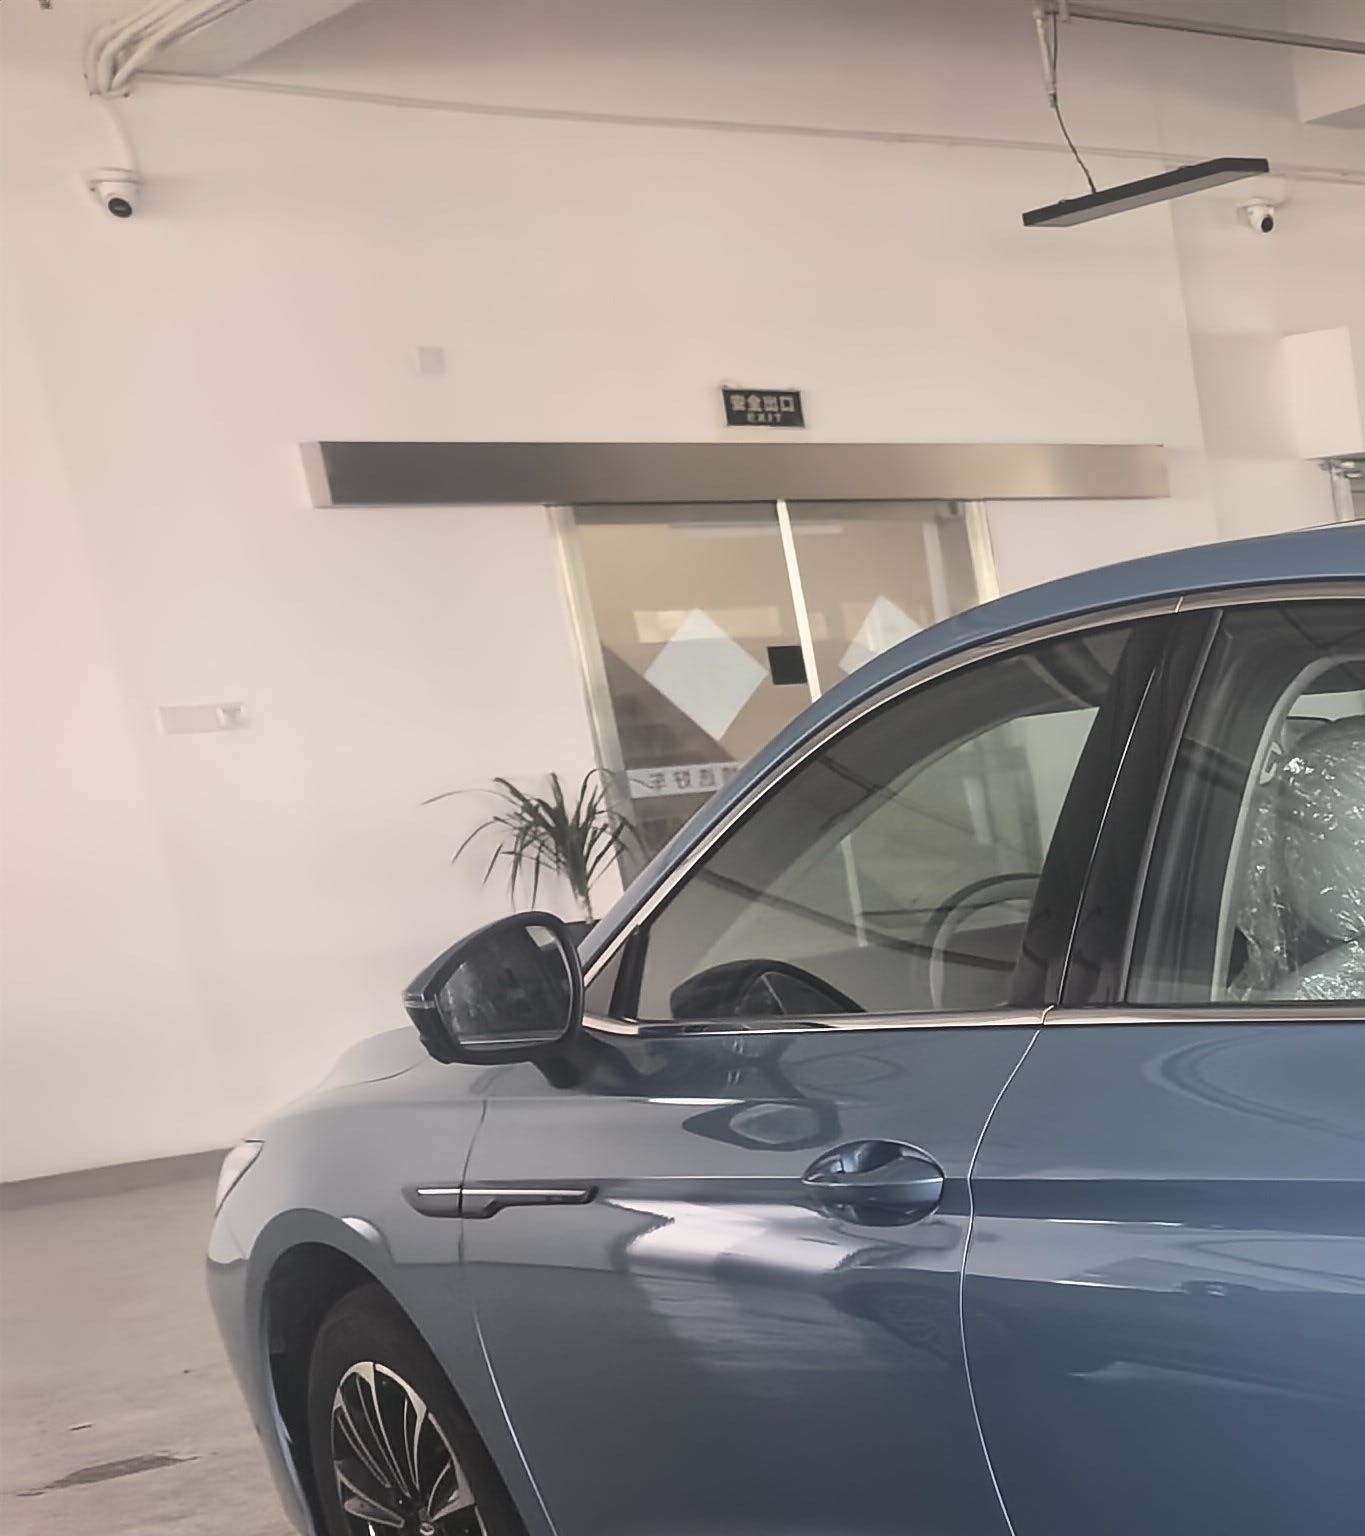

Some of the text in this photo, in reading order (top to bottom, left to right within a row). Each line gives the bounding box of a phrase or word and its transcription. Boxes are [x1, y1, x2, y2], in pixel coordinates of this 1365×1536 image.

[729, 394, 796, 412] 安全出口
[747, 412, 782, 423] EXIT
